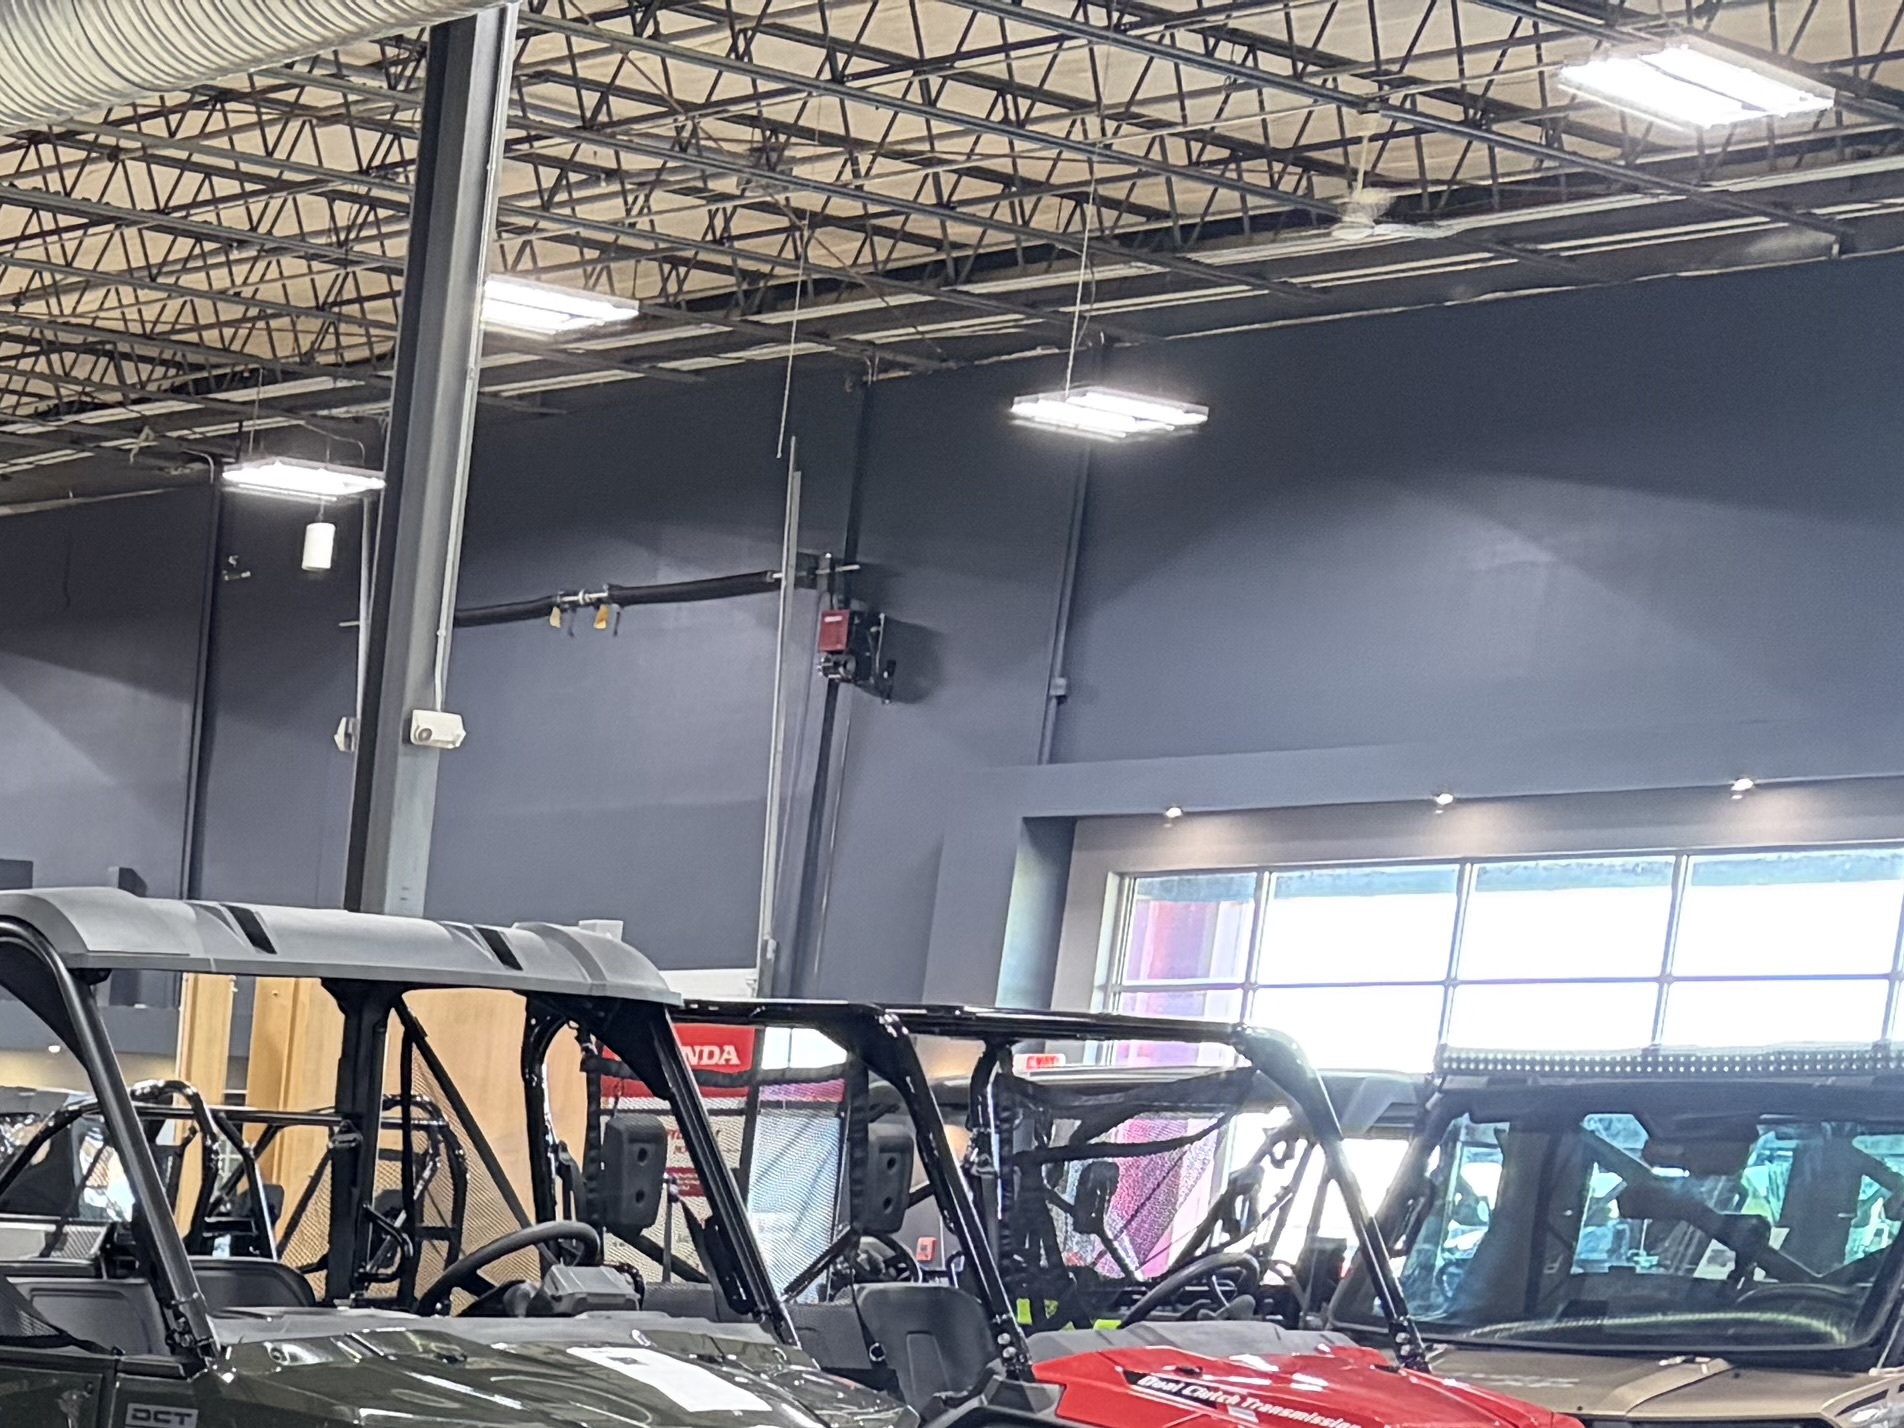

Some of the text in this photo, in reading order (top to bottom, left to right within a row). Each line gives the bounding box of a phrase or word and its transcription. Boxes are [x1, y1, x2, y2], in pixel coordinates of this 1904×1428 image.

[684, 1046, 741, 1065] NDA
[1136, 1375, 1185, 1393] Dual
[1181, 1384, 1241, 1405] Clutch
[131, 1408, 192, 1425] DCT
